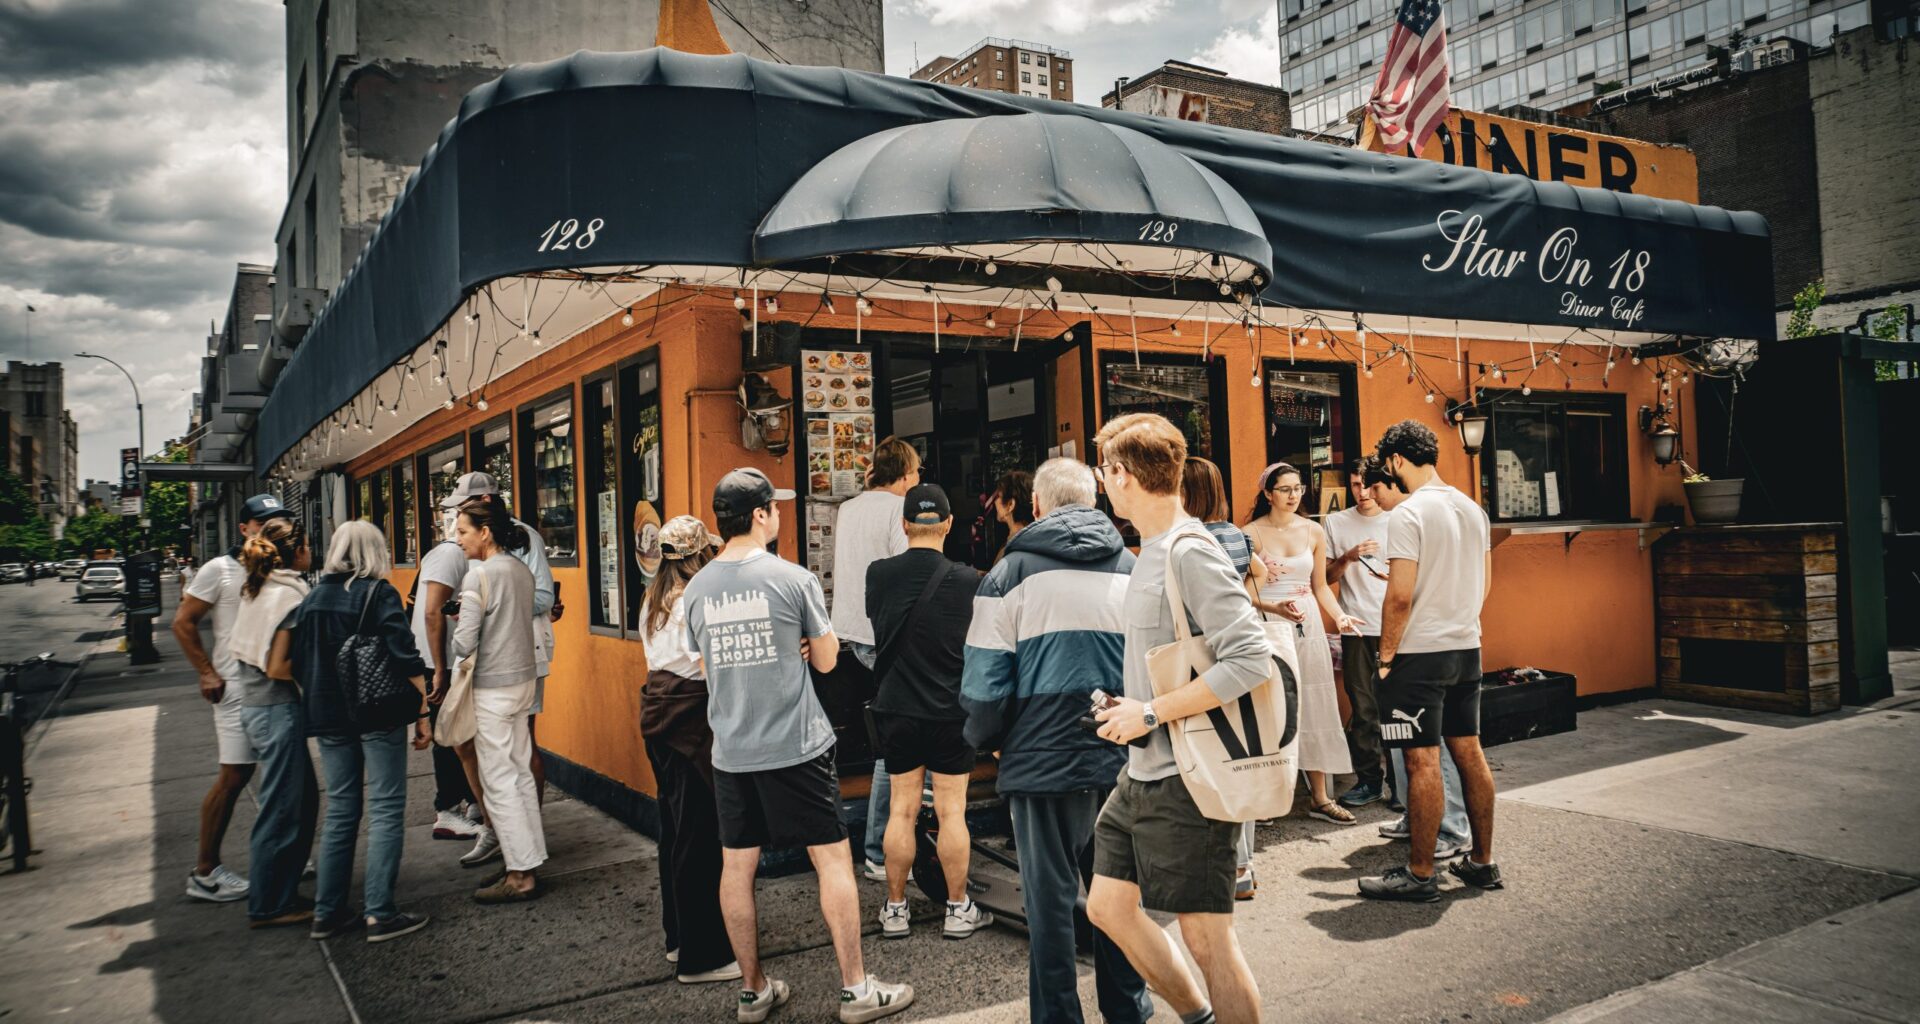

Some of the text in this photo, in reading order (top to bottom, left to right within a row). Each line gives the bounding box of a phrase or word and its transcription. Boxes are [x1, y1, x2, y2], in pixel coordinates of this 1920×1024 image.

[538, 218, 605, 252] 128
[1138, 220, 1179, 243] 128
[1422, 210, 1651, 292] Star On 18
[1559, 291, 1645, 328] Diner Café
[1286, 405, 1320, 421] WINE
[1326, 492, 1341, 514] A
[707, 620, 772, 636] THAT'S THE
[711, 630, 773, 652] SPIRIT
[712, 645, 777, 664] SHOPPE
[1380, 723, 1413, 740] UMA
